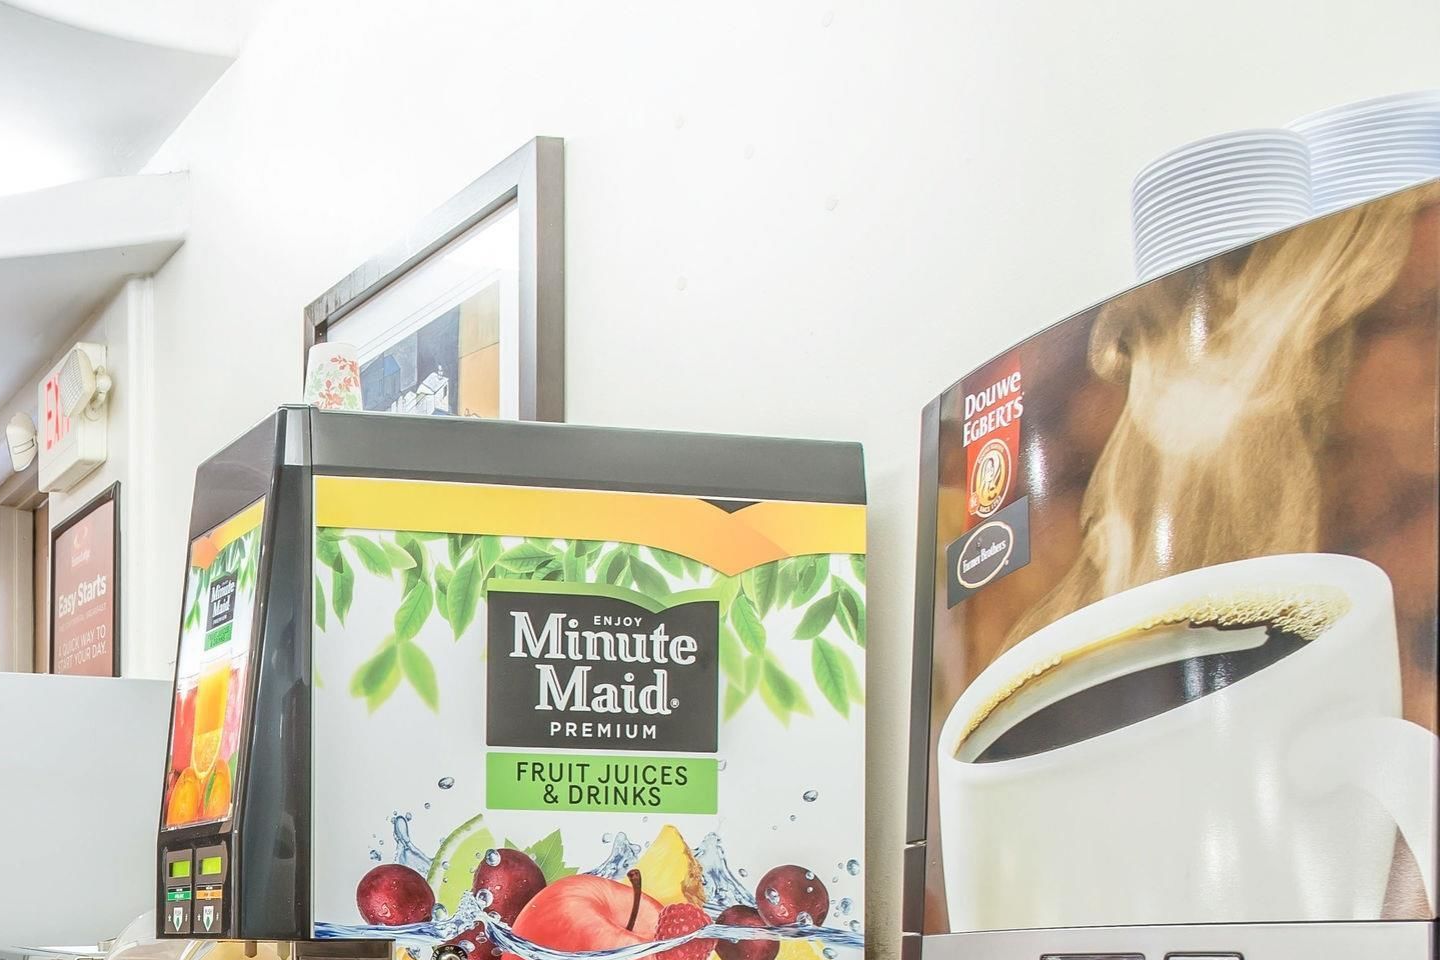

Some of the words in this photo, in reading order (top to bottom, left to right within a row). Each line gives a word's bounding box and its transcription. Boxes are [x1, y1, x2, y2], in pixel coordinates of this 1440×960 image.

[59, 591, 77, 618] Easy
[77, 573, 107, 607] Starts
[96, 624, 106, 640] TO
[594, 616, 642, 627] ENJOY
[509, 611, 698, 665] Minute
[550, 722, 657, 739] PREMIUM
[517, 762, 590, 783] FRUIT
[597, 765, 688, 786] JUICES
[543, 784, 559, 804] &
[569, 786, 661, 807] DRINKS
